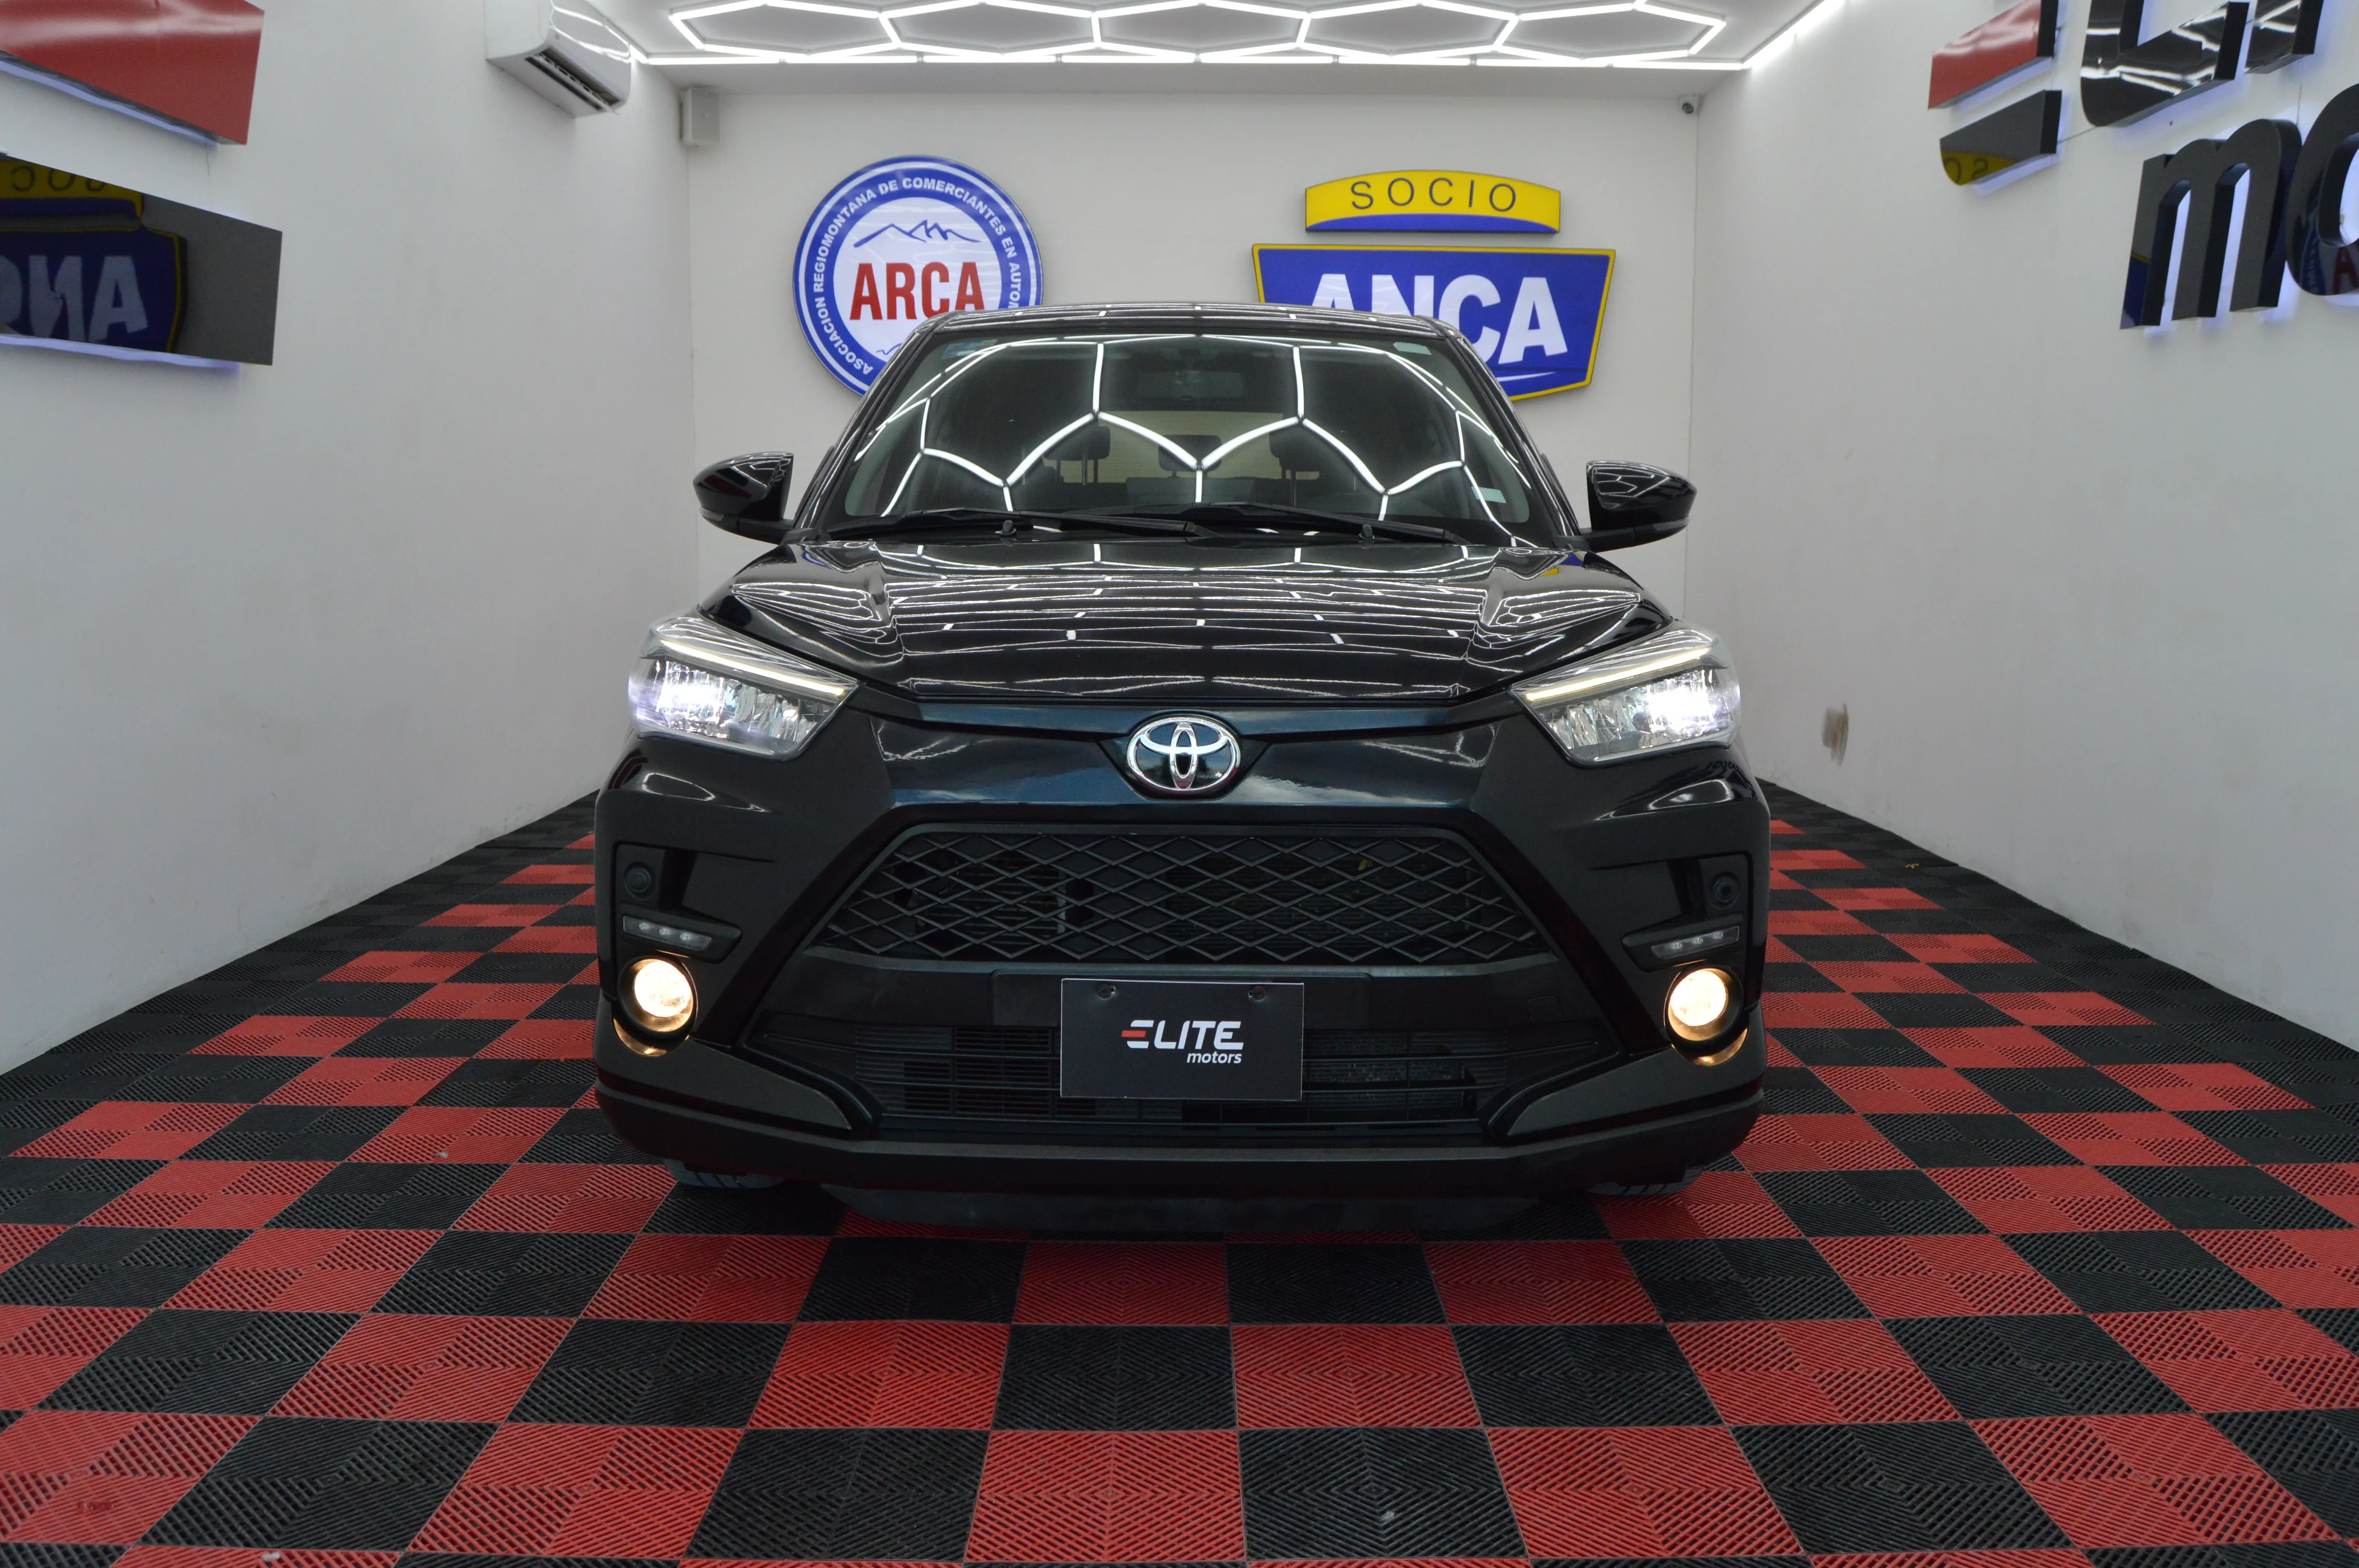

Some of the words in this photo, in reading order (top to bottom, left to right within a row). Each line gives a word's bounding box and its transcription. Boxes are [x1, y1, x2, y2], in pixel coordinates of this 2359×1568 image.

[878, 180, 899, 195] DE
[1351, 178, 1516, 212] SOCIO
[902, 177, 1006, 236] COMERCIANTES
[814, 189, 877, 293] REGIOMONTANA
[1001, 236, 1017, 259] EN
[850, 261, 985, 320] ARCA
[815, 296, 874, 375] ASOCIACION
[1121, 1020, 1244, 1050] ELITE
[1186, 1050, 1242, 1064] motors
